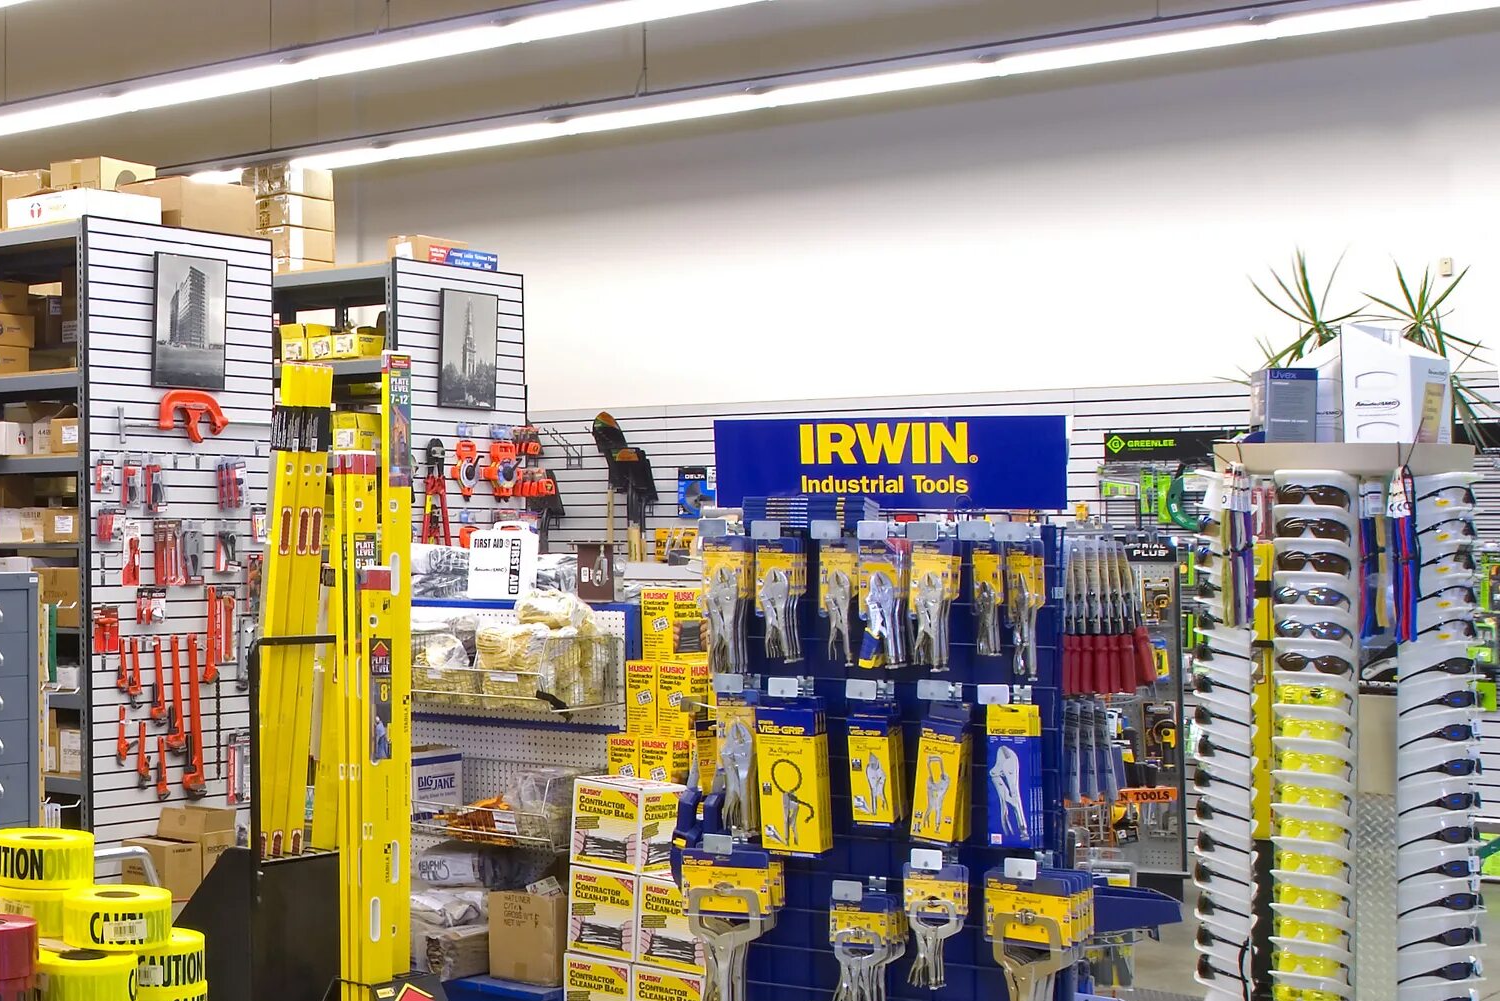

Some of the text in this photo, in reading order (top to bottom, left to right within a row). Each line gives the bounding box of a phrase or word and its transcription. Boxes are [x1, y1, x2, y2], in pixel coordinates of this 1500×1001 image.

[1271, 370, 1297, 379] Uvex
[390, 377, 410, 386] PLATE
[390, 385, 410, 393] LEVEL
[799, 421, 970, 466] IRWIN
[1127, 439, 1175, 448] GREENLEE
[801, 474, 969, 495] Industrial Tools
[355, 541, 376, 550] PLATE
[473, 538, 504, 548] FIRST AID
[356, 549, 375, 557] LEVEL
[1132, 549, 1166, 557] PLUS
[508, 539, 521, 595] FIRST AID
[673, 591, 695, 601] HUSKY
[628, 665, 653, 673] HUSKY
[659, 666, 686, 674] HUSKY
[758, 724, 805, 735] VISE-GRIP
[989, 727, 1027, 735] VISE-GRIP
[610, 738, 635, 746] HUSKY
[641, 740, 669, 749] HUSKY
[417, 775, 456, 790] BIG JAKE
[579, 786, 602, 797] HUSKY
[1134, 790, 1170, 801] TOOLS
[579, 795, 626, 810] CONTRACTOR
[614, 809, 635, 820] BAGS
[575, 873, 597, 883] HUSKY
[575, 881, 621, 897] CONTRACTOR
[645, 884, 669, 895] HUSKY
[610, 895, 631, 907] BAGS
[569, 961, 592, 972] HUSKY
[569, 969, 616, 985] CONTRACTOR
[638, 973, 662, 984] HUSKY
[604, 983, 625, 995] BAGS
[638, 980, 688, 998] CONTRACTOR
